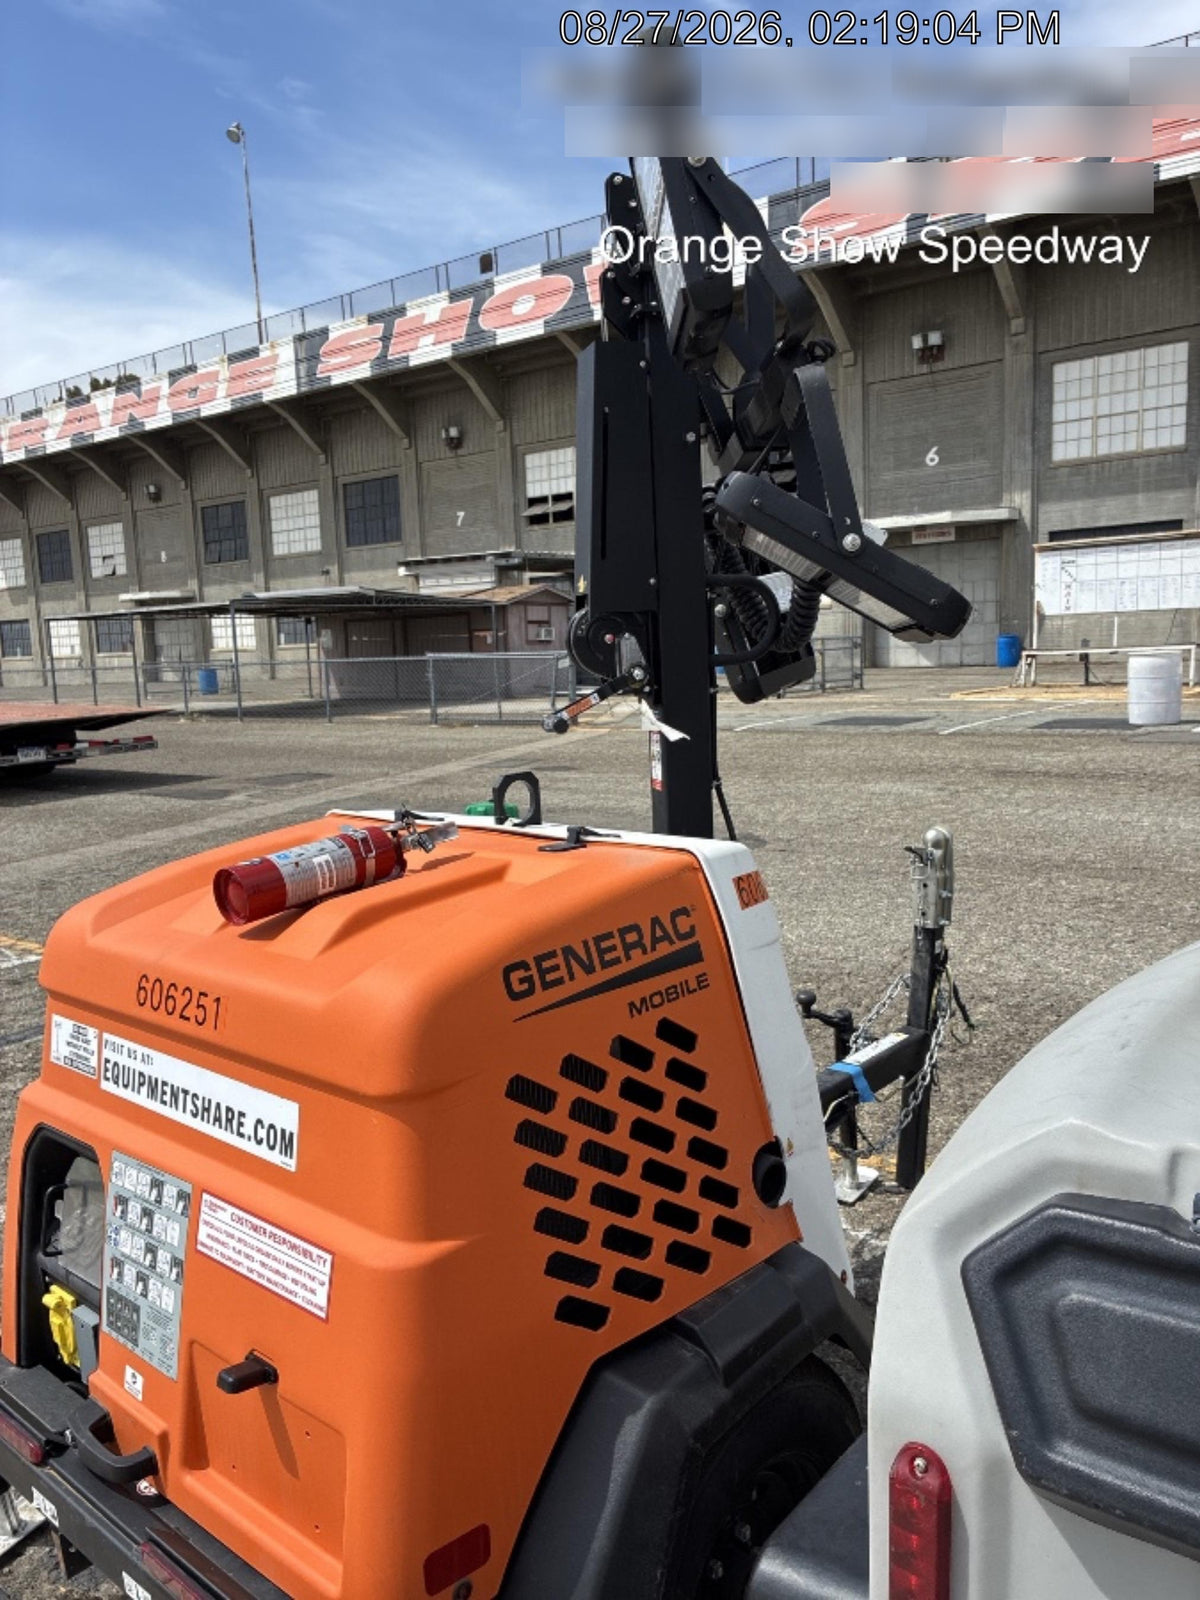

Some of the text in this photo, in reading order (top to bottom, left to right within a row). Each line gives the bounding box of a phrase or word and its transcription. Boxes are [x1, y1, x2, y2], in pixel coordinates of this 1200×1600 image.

[0, 260, 608, 453] RANGE SHO
[925, 445, 940, 467] 6
[456, 511, 465, 527] 7
[502, 905, 697, 1001] GENERAC
[136, 973, 222, 1030] 606251
[627, 972, 711, 1019] MOBILE
[104, 1038, 124, 1056] VISIT
[127, 1046, 138, 1061] US
[103, 1057, 295, 1160] EQUIPMENTSHARE.COM
[230, 1211, 267, 1238] CUSTOMER
